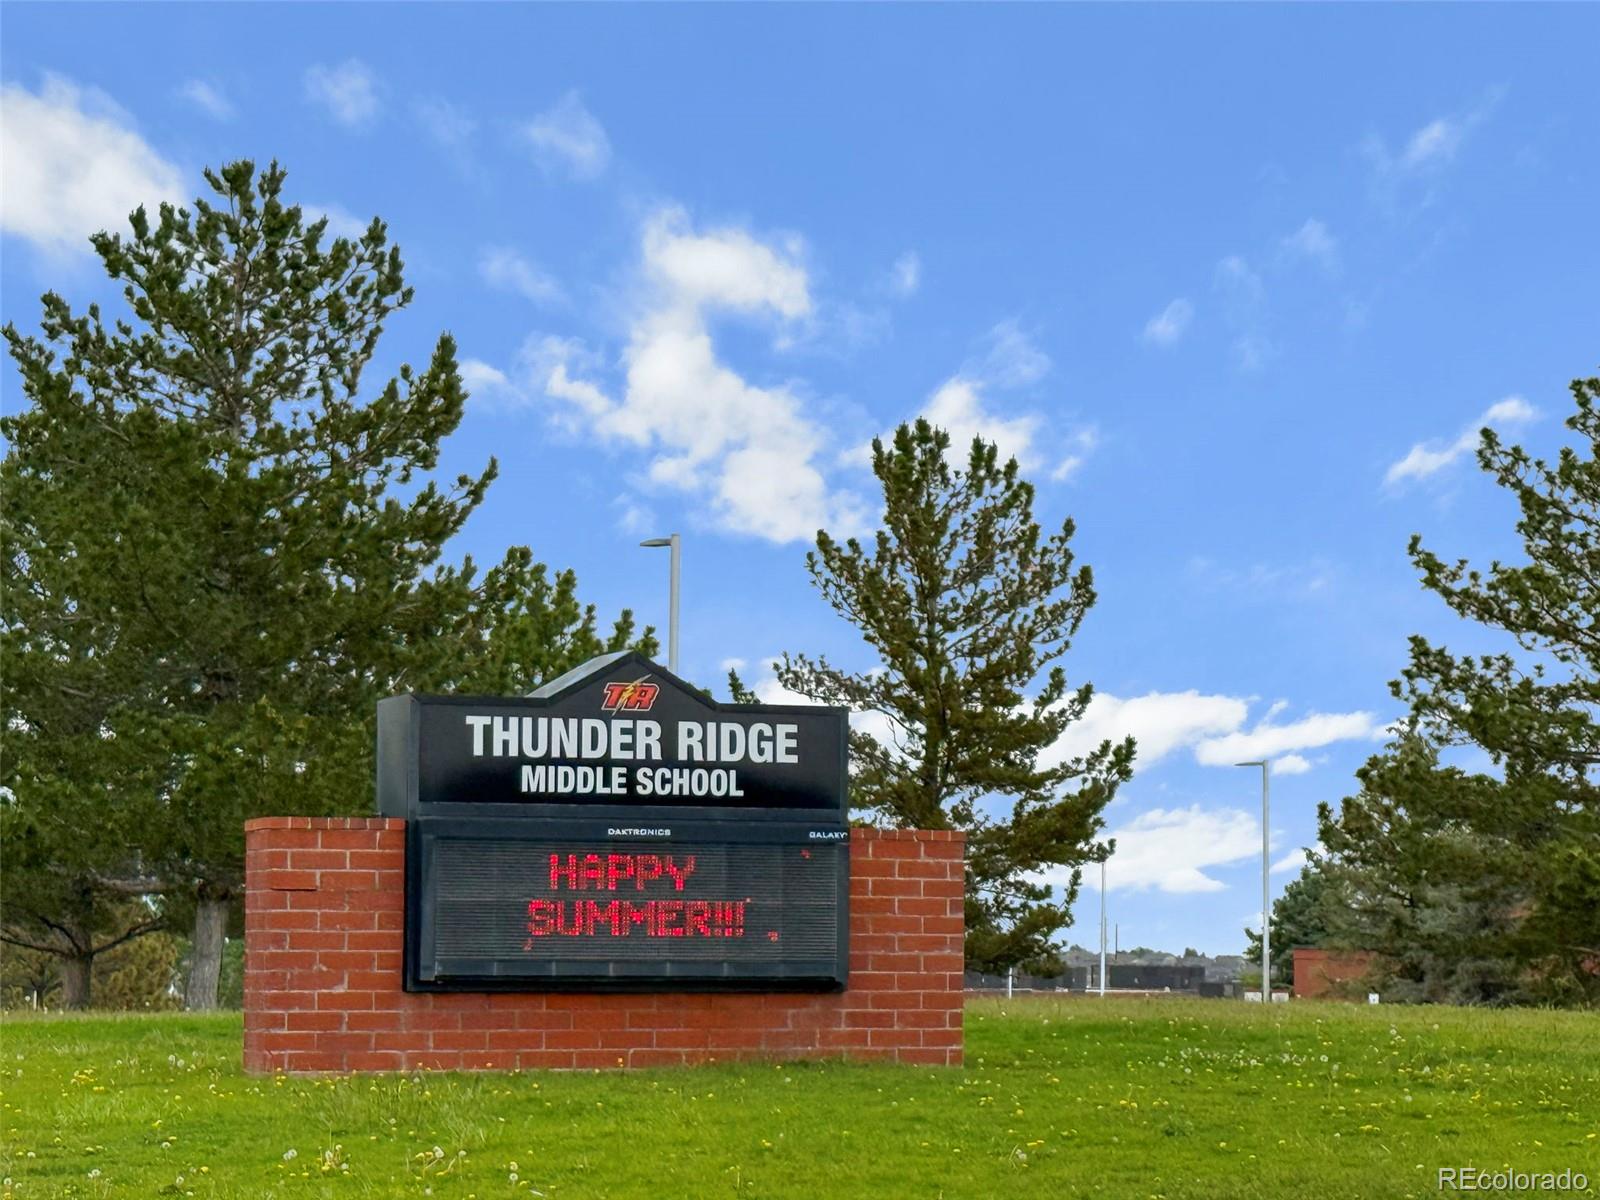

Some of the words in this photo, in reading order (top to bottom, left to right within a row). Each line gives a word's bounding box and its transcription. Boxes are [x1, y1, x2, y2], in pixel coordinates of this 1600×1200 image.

[465, 715, 662, 761] THUNDER
[677, 721, 799, 764] RIDGE
[521, 765, 627, 795] MIDDLE
[636, 767, 744, 797] SCHOOL
[607, 828, 672, 836] DAKTRONICS
[549, 854, 697, 891] HAPPY
[527, 898, 745, 937] SUMMER!!!
